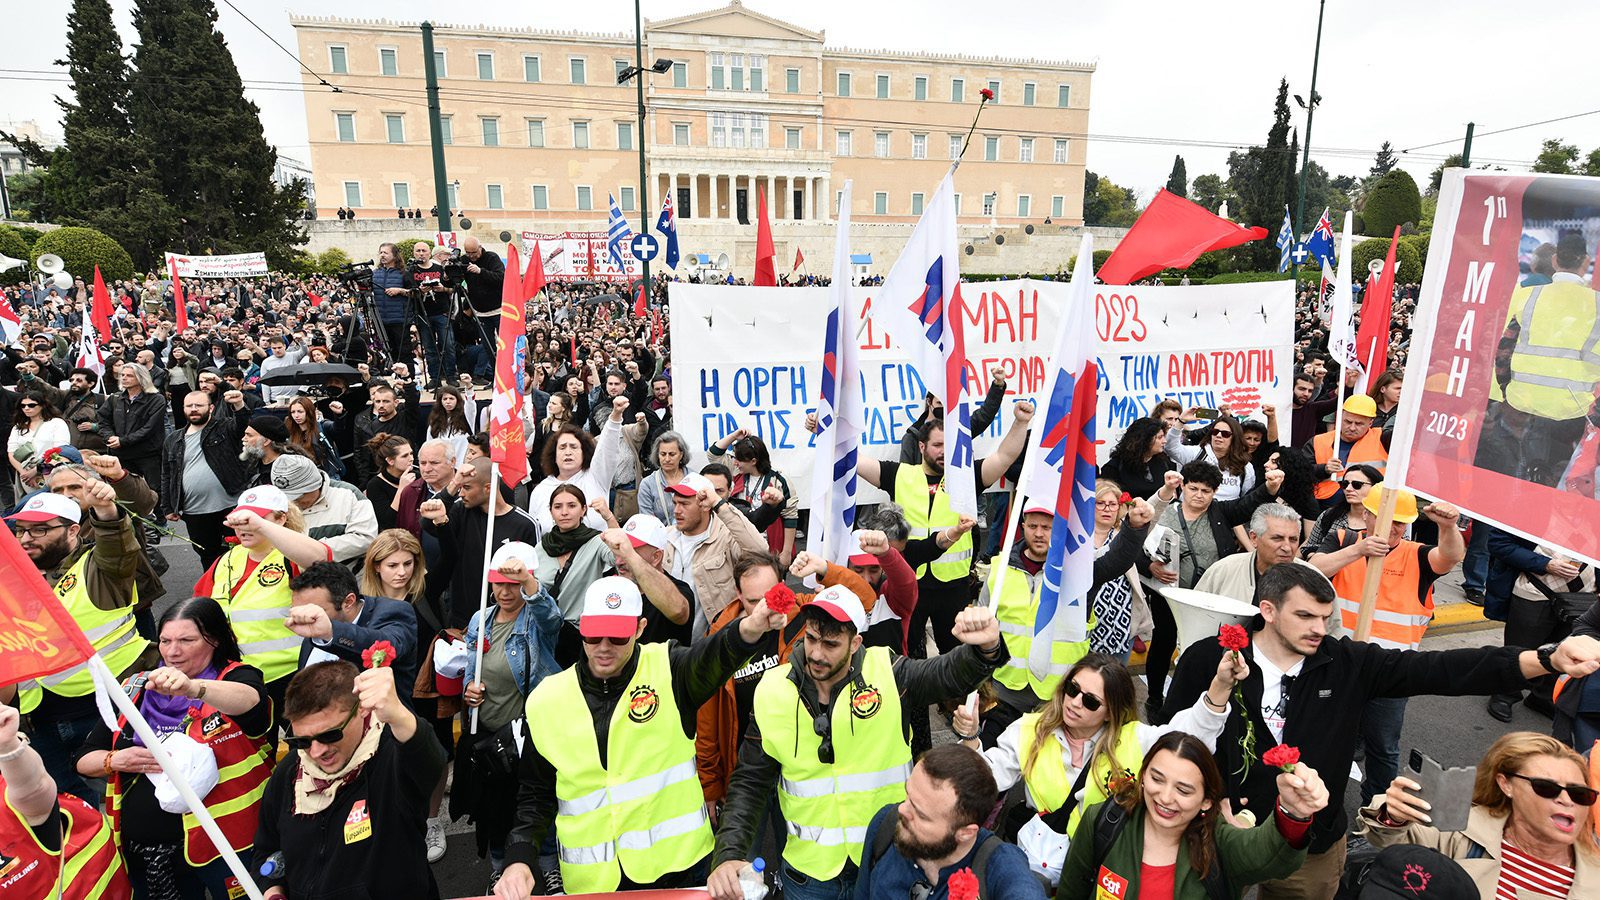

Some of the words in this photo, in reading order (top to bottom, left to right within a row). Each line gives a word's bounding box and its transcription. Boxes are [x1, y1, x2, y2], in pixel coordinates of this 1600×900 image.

[1095, 293, 1147, 343] 023
[700, 368, 720, 408] Η
[733, 366, 807, 407] ΟΡΓΗ
[964, 355, 1051, 397] ΑΓΩΝΑ
[1120, 354, 1161, 391] ΤΗΝ
[1168, 349, 1279, 388] ΑΝΑΤΡΟΠΗ,
[749, 410, 795, 449] ΤΙΣ
[1426, 411, 1469, 441] 2023
[203, 716, 221, 732] cgt
[214, 730, 243, 744] YVELINES
[1, 859, 39, 889] YVELINES
[1102, 875, 1121, 895] cgt
